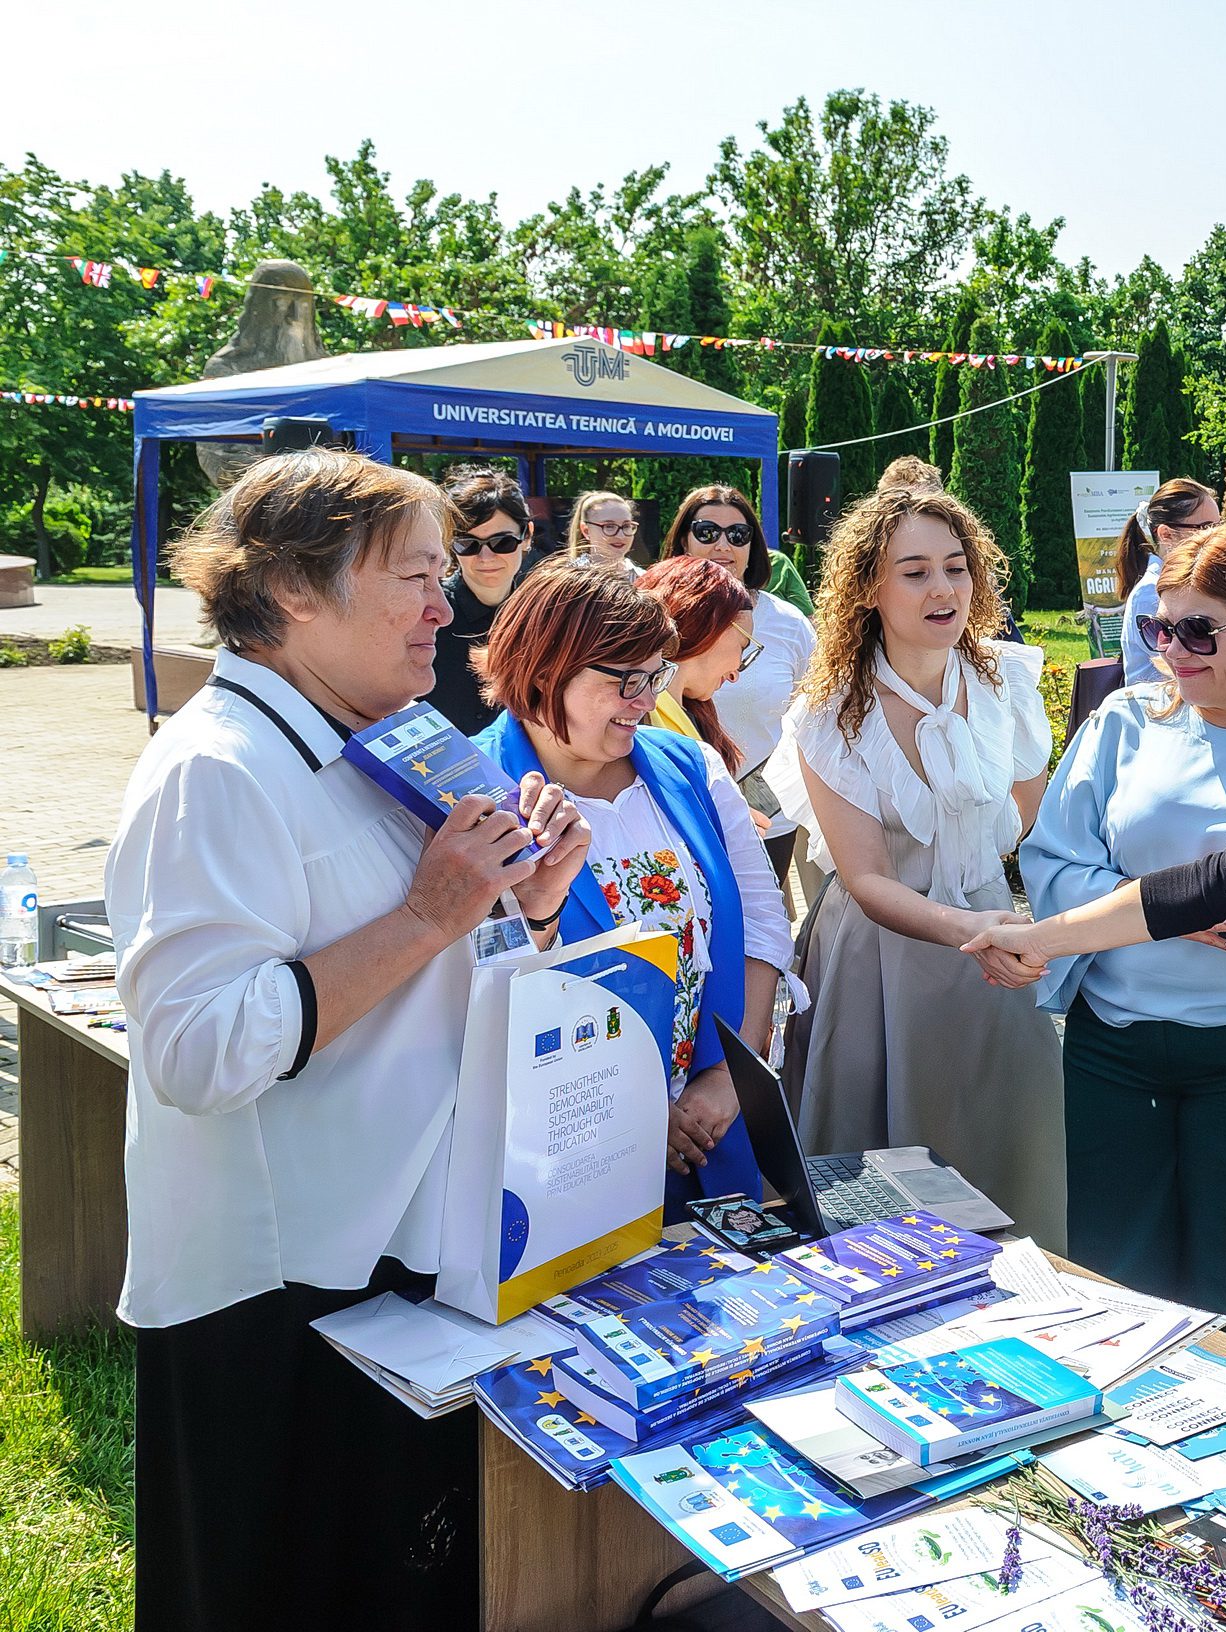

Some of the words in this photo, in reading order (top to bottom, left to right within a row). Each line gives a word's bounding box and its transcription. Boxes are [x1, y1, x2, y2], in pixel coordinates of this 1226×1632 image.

[433, 404, 567, 430] UNIVERSITATEA
[570, 414, 637, 435] TEHNICĂ
[644, 422, 656, 436] A
[657, 422, 734, 442] MOLDOVEI
[549, 1064, 619, 1100] STRENGTHENING
[549, 1083, 604, 1114] DEMOCRATIC
[548, 1093, 615, 1129] SUSTAINABILITY
[548, 1115, 592, 1142] THROUGH
[593, 1107, 614, 1124] CIVIC
[547, 1128, 597, 1156] EDUCATION
[1125, 1388, 1178, 1411] CONNECT
[1137, 1396, 1191, 1420] CONNECT
[1151, 1398, 1205, 1422] CONNECT
[993, 1418, 1038, 1437] INTERNAȚIONALĂ
[1167, 1406, 1221, 1429] CONNECT
[956, 1436, 980, 1447] MONNET
[980, 1430, 994, 1440] JEAN
